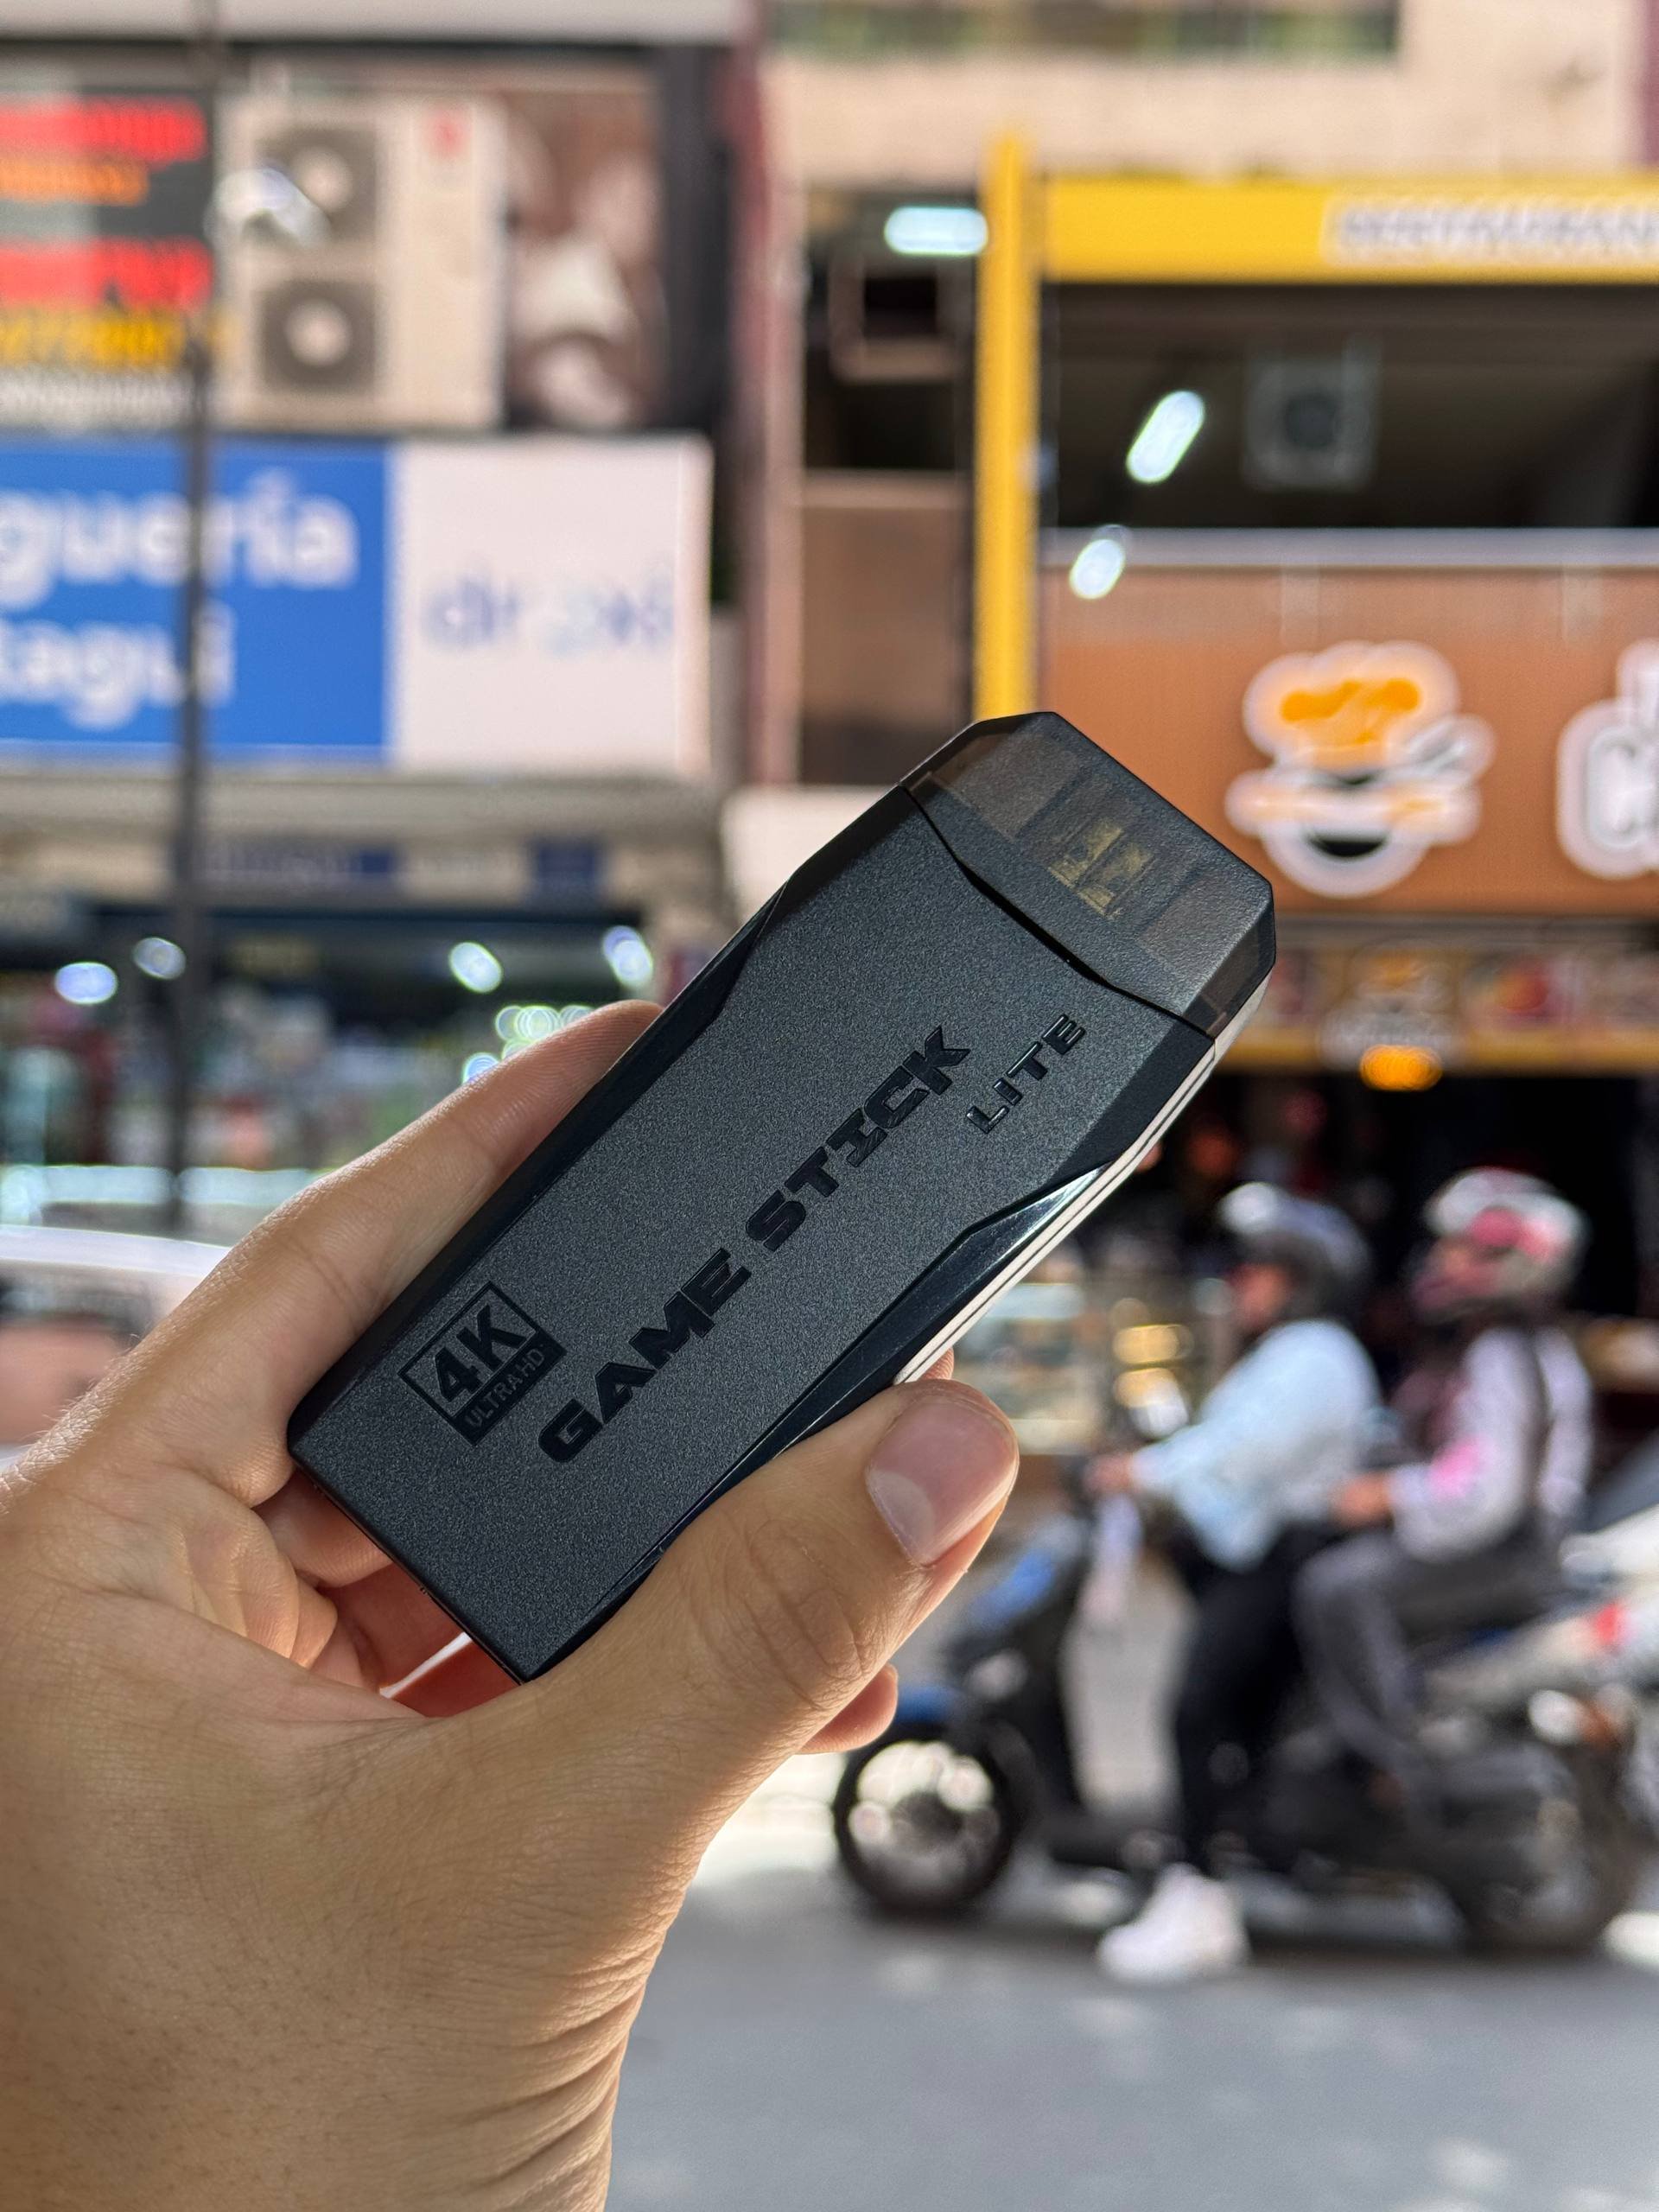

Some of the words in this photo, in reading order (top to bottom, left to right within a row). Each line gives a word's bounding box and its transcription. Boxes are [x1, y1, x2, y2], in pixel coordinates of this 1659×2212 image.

[965, 1013, 1086, 1135] LITE
[537, 1247, 752, 1463] GAME
[745, 1025, 970, 1251] STICK
[434, 1304, 528, 1402] 4K
[464, 1373, 523, 1427] ULTRA
[519, 1348, 545, 1377] HD
